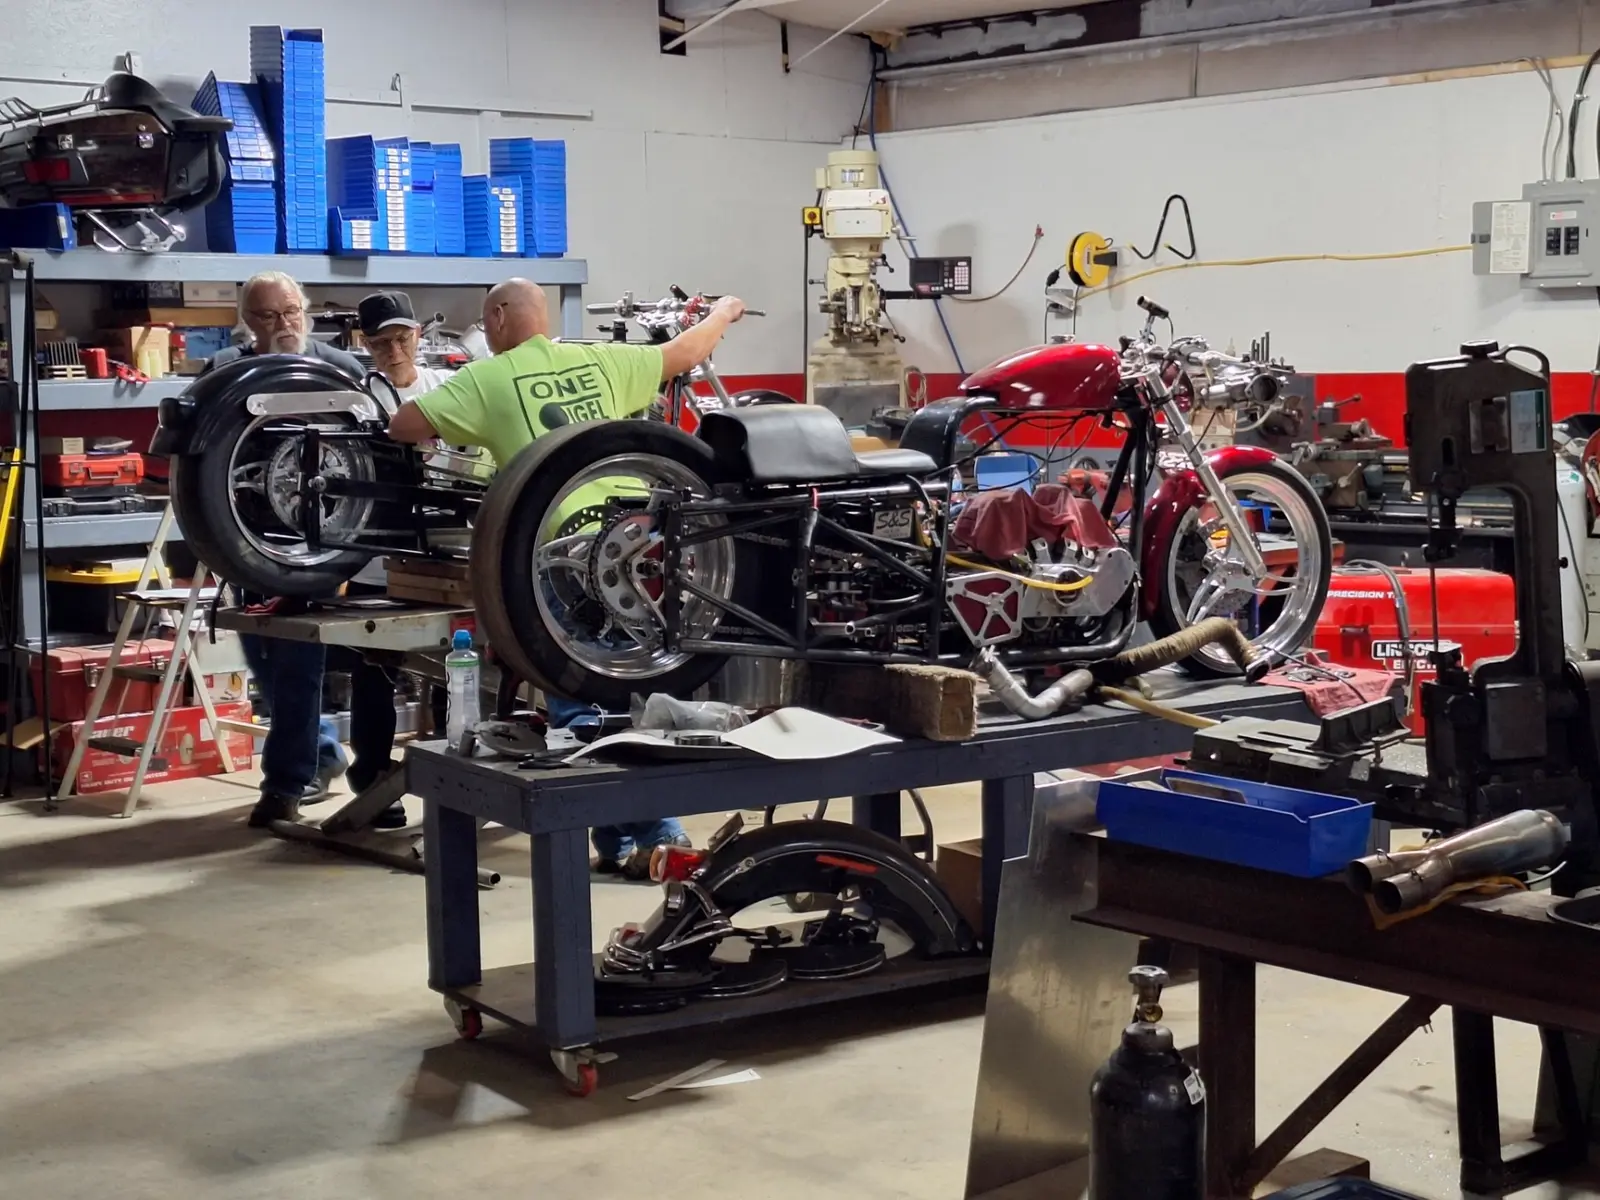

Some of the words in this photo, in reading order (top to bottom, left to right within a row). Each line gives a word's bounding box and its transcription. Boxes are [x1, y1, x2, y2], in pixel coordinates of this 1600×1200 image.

[530, 372, 598, 398] ONE
[876, 510, 911, 529] S&S
[1327, 590, 1384, 599] PRECISION
[1376, 643, 1438, 657] LINO
